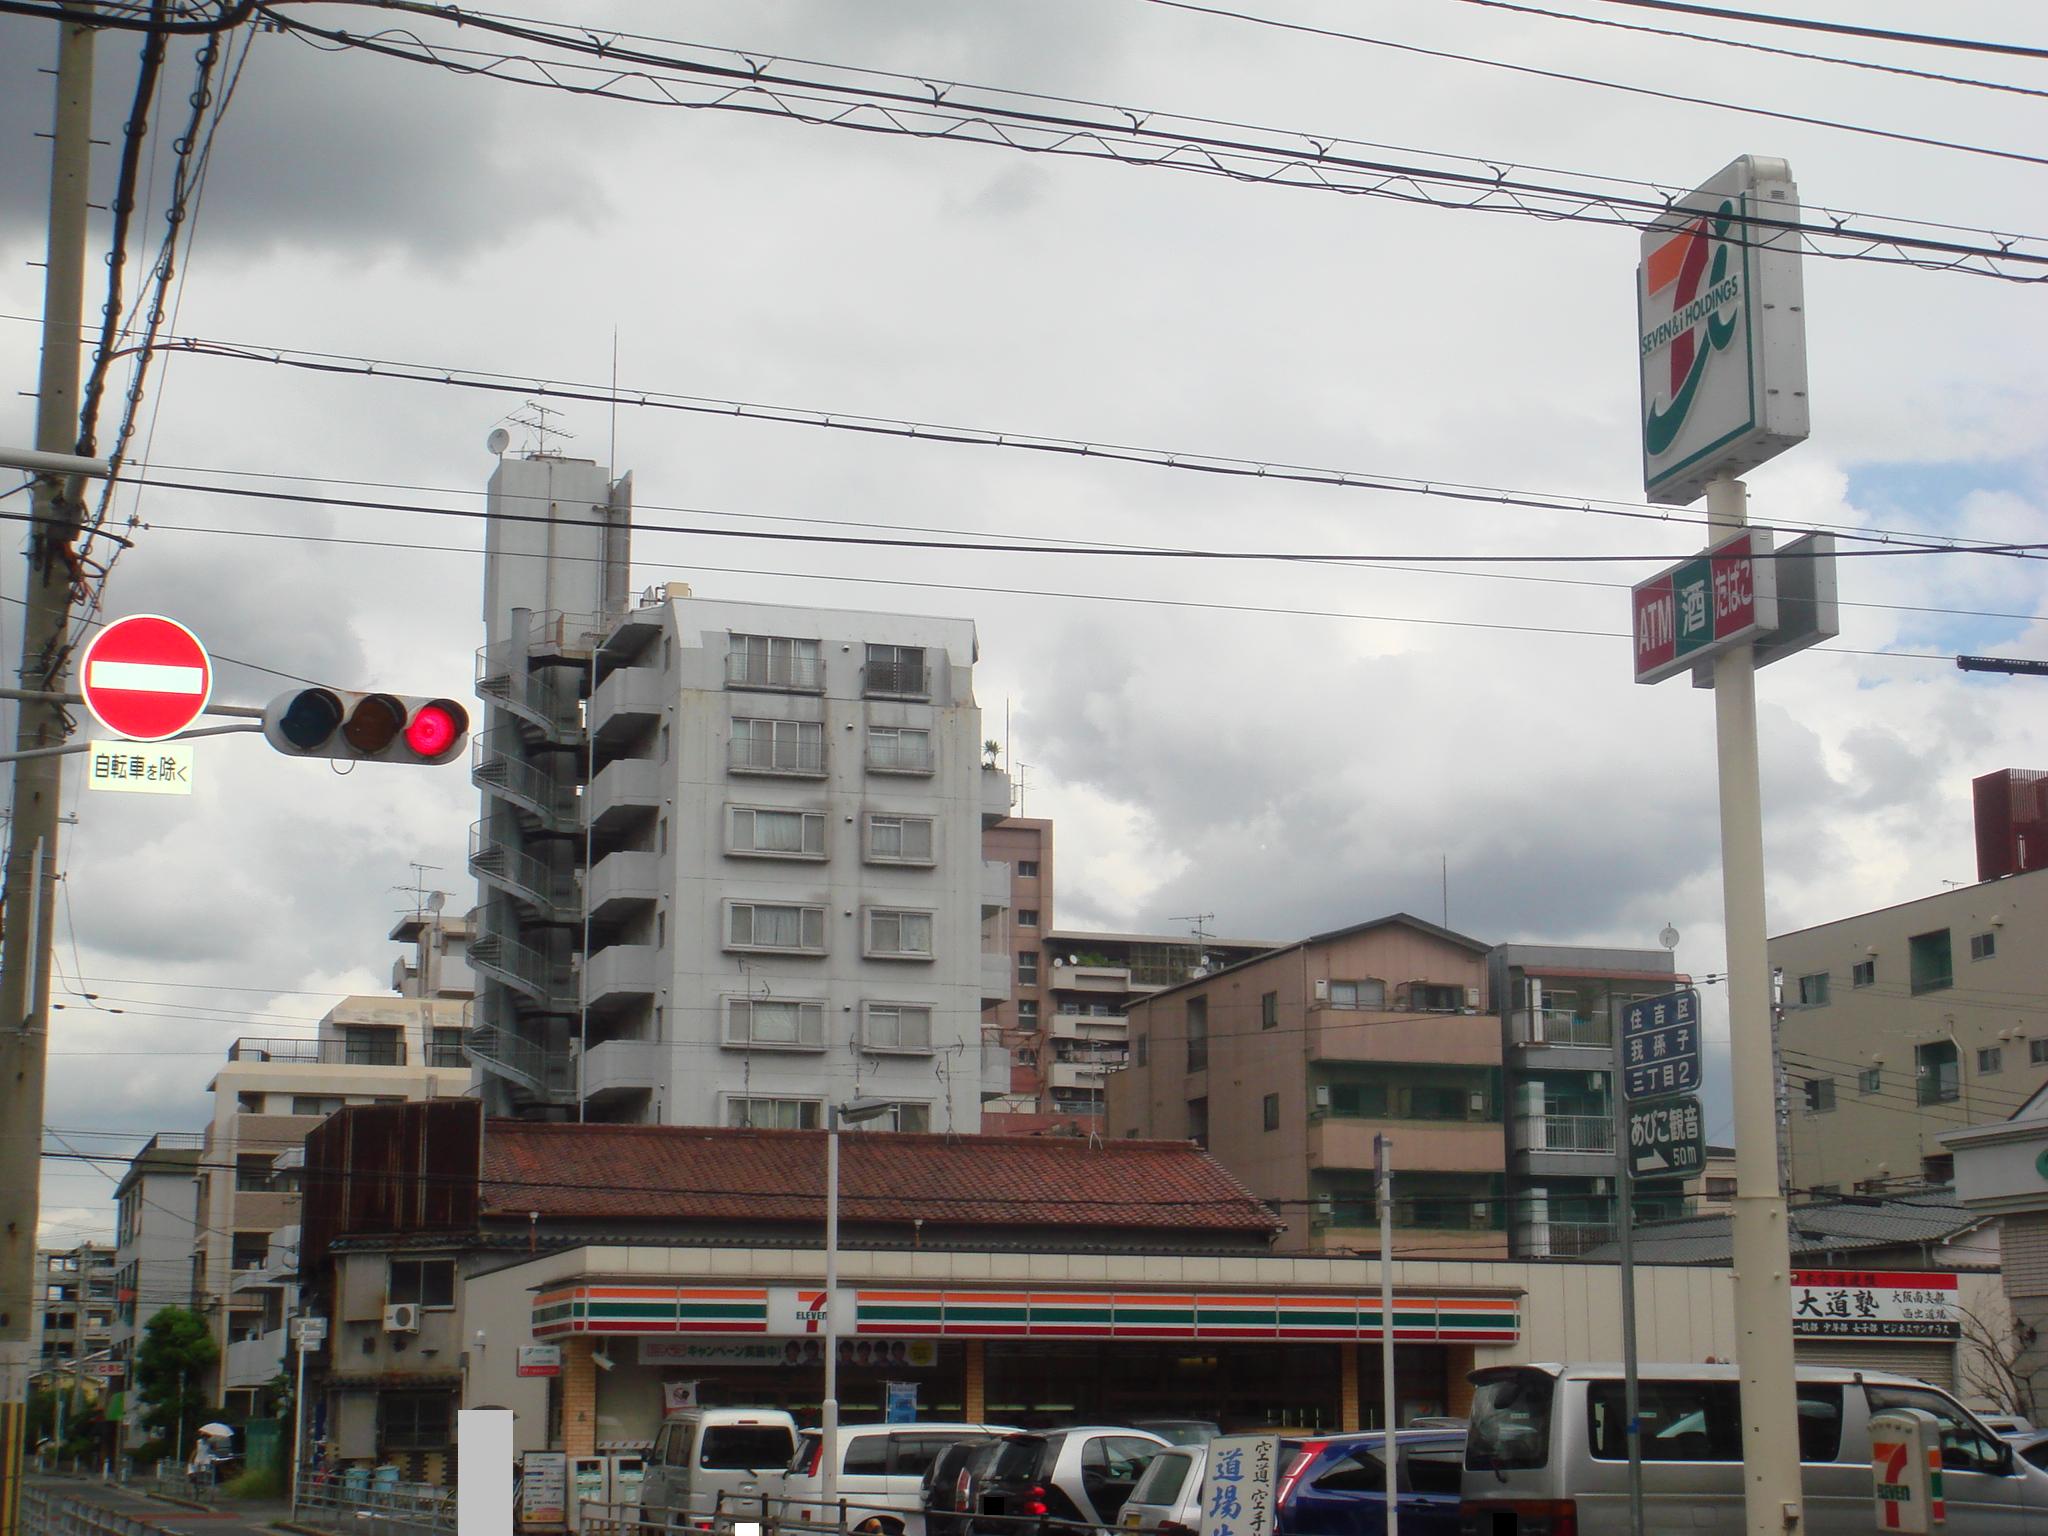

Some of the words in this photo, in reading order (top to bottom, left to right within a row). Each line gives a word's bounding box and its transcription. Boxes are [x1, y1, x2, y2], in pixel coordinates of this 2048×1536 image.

[1685, 275, 1738, 327] HOLDINGS
[1716, 559, 1752, 619] たばこ
[1639, 595, 1672, 654] ATM
[1682, 579, 1705, 637] 酒
[95, 753, 188, 782] 自転車を除く
[1630, 998, 1689, 1031] 住吉区
[1631, 1029, 1689, 1062] 我孫子
[1632, 1061, 1690, 1093] 三丁目2
[1631, 1104, 1698, 1147] あびこ観音
[1673, 1146, 1697, 1167] 50m
[1797, 1288, 1880, 1318] 大道塾
[1892, 1290, 1945, 1304] 大阪南支部
